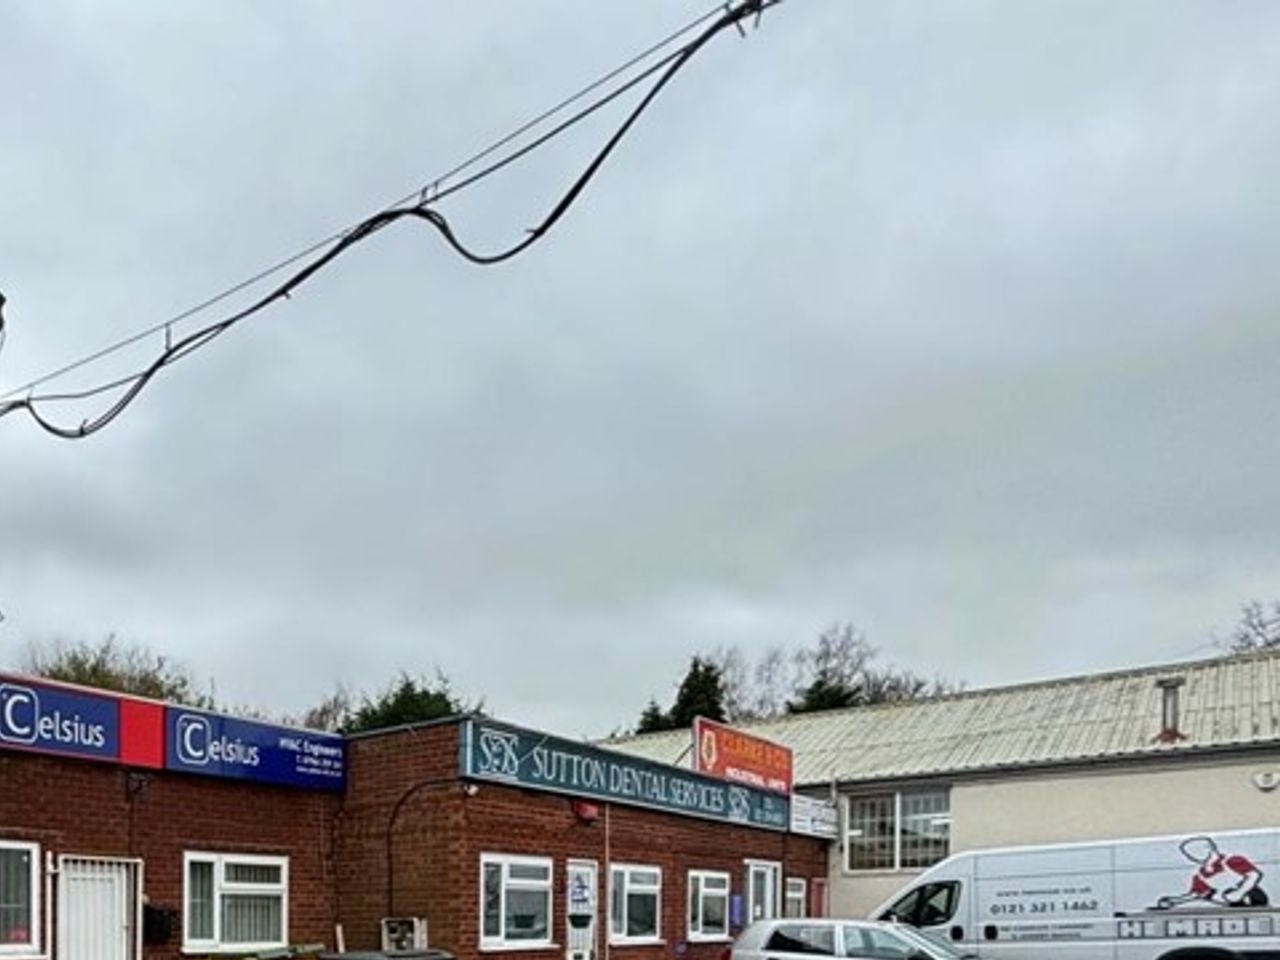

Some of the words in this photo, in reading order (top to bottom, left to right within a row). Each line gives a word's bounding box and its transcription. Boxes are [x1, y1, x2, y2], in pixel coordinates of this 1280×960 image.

[2, 693, 106, 748] Celsius
[181, 722, 261, 766] Celsius
[531, 746, 606, 789] SUTTON
[609, 763, 668, 801] DENTAL
[670, 778, 724, 812] SERVICES
[989, 903, 1025, 914] 0121
[1030, 901, 1055, 912] 321
